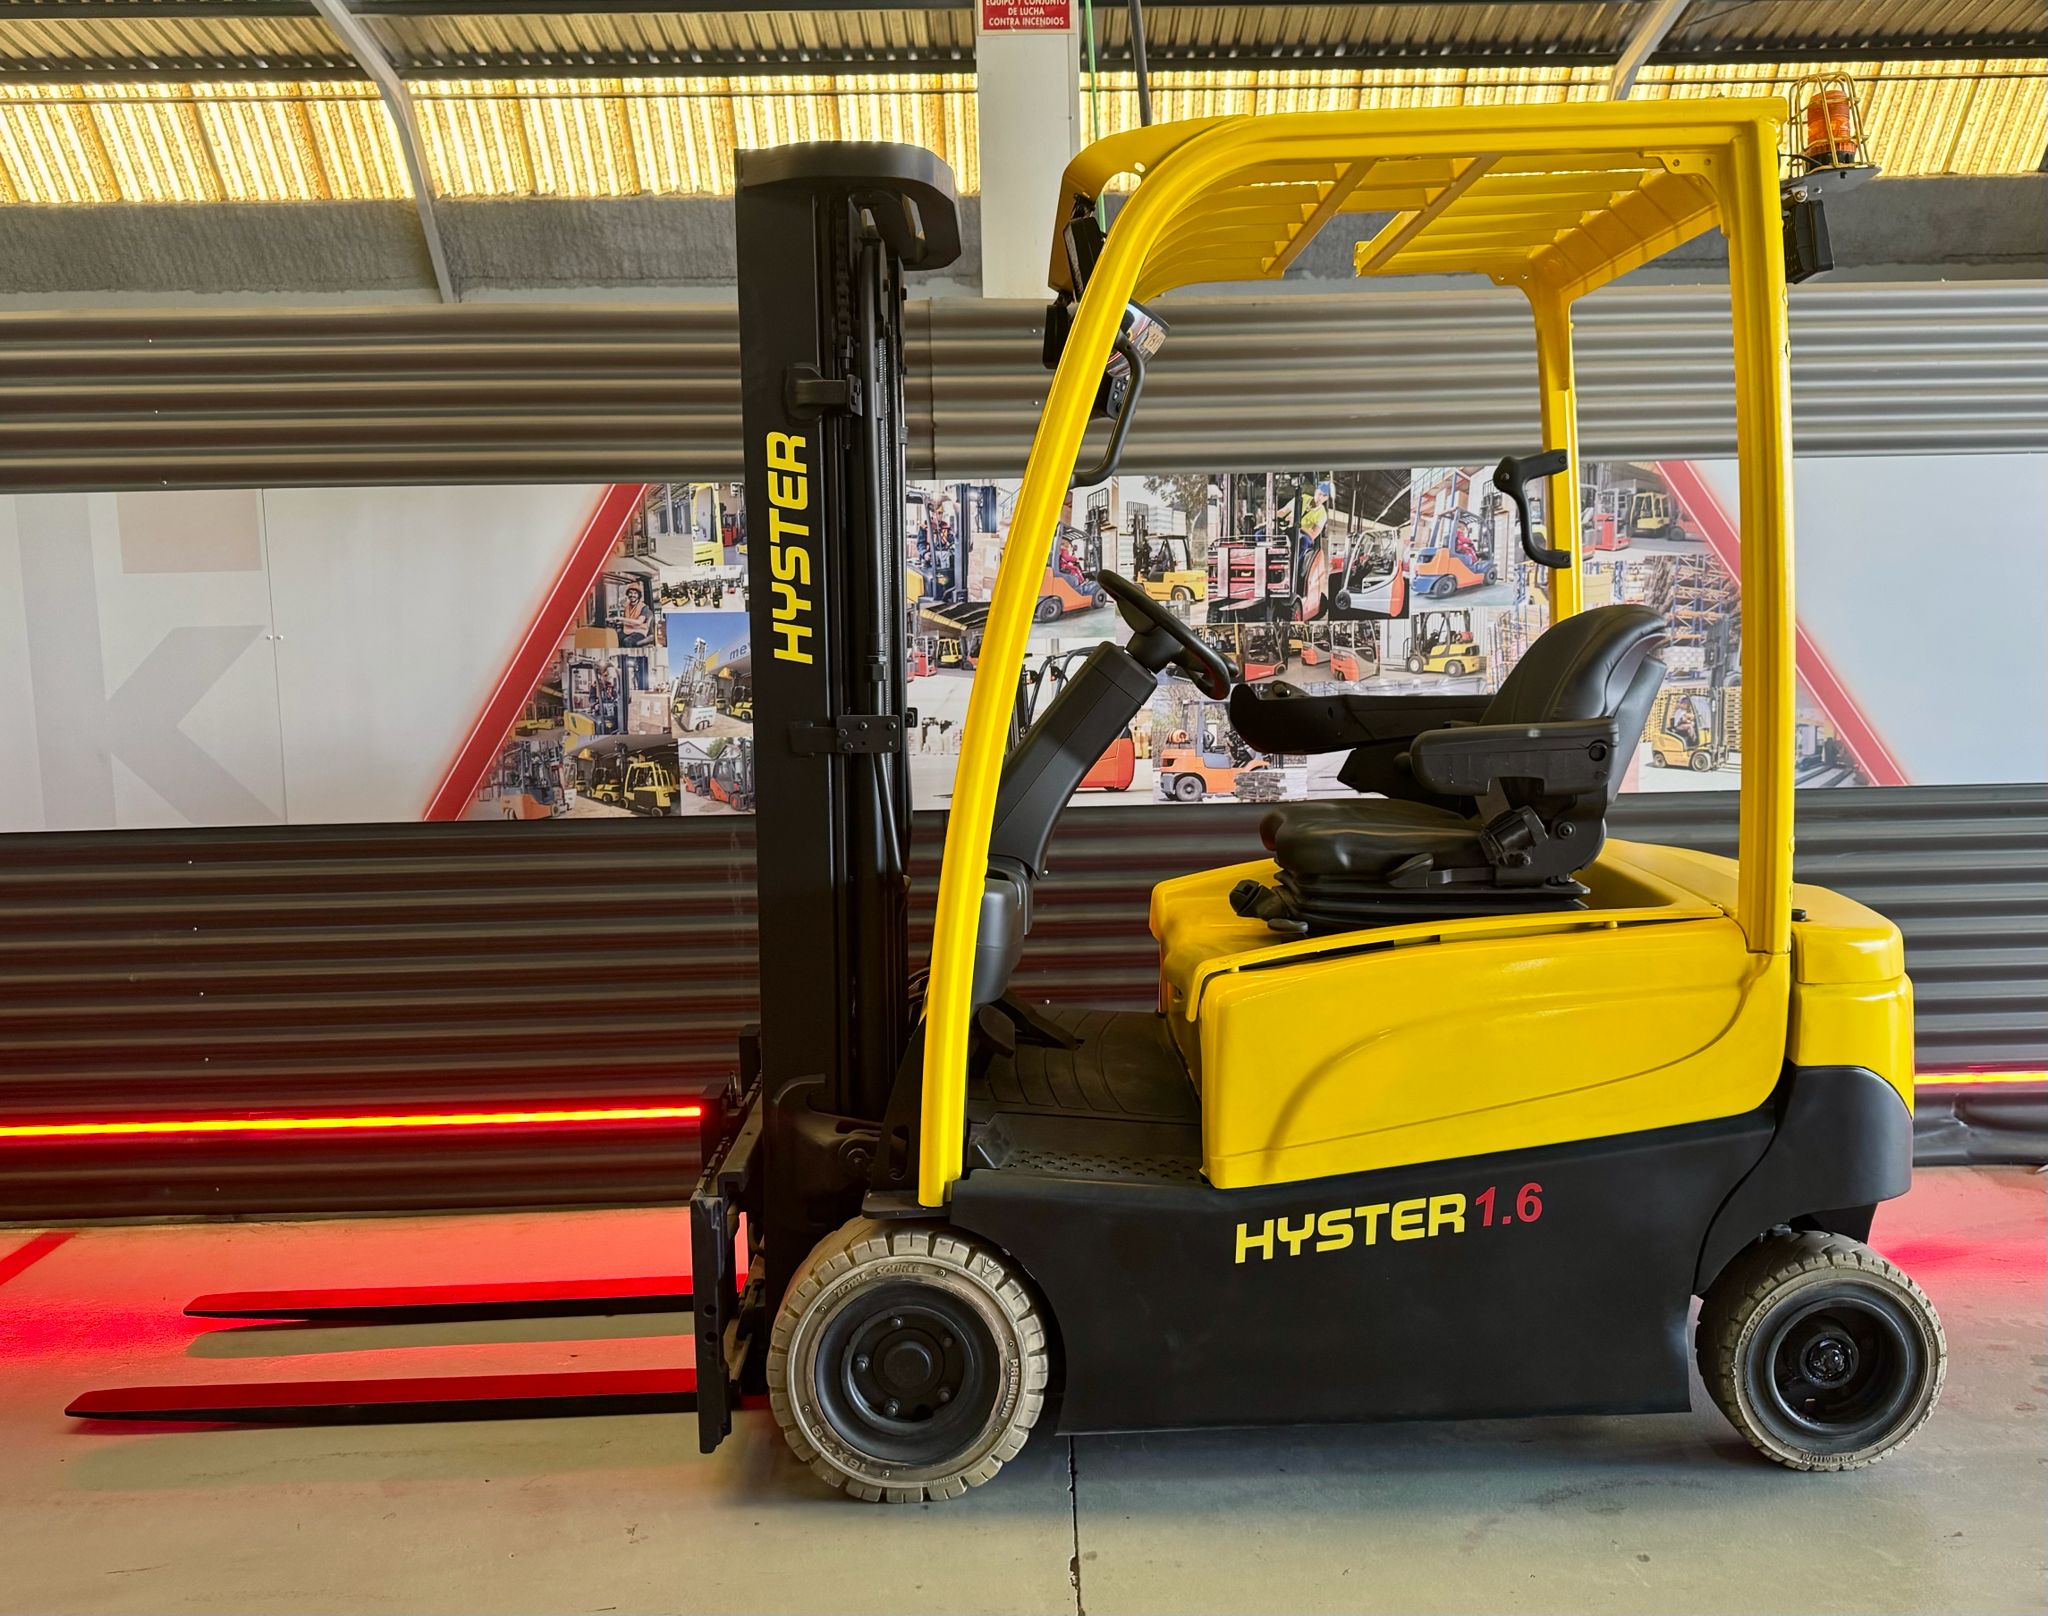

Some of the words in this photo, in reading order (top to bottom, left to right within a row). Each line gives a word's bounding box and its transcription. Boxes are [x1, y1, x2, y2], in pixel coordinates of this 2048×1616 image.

[988, 17, 1020, 26] CONTRA
[1022, 16, 1065, 26] INCENDIOS
[1008, 7, 1018, 16] DE
[1020, 6, 1045, 16] LUCHA
[766, 431, 814, 665] HYSTER
[729, 642, 750, 660] me
[1235, 1193, 1467, 1264] HYSTER
[1475, 1182, 1544, 1228] 1.6
[1001, 1358, 1020, 1418] PREMIUM
